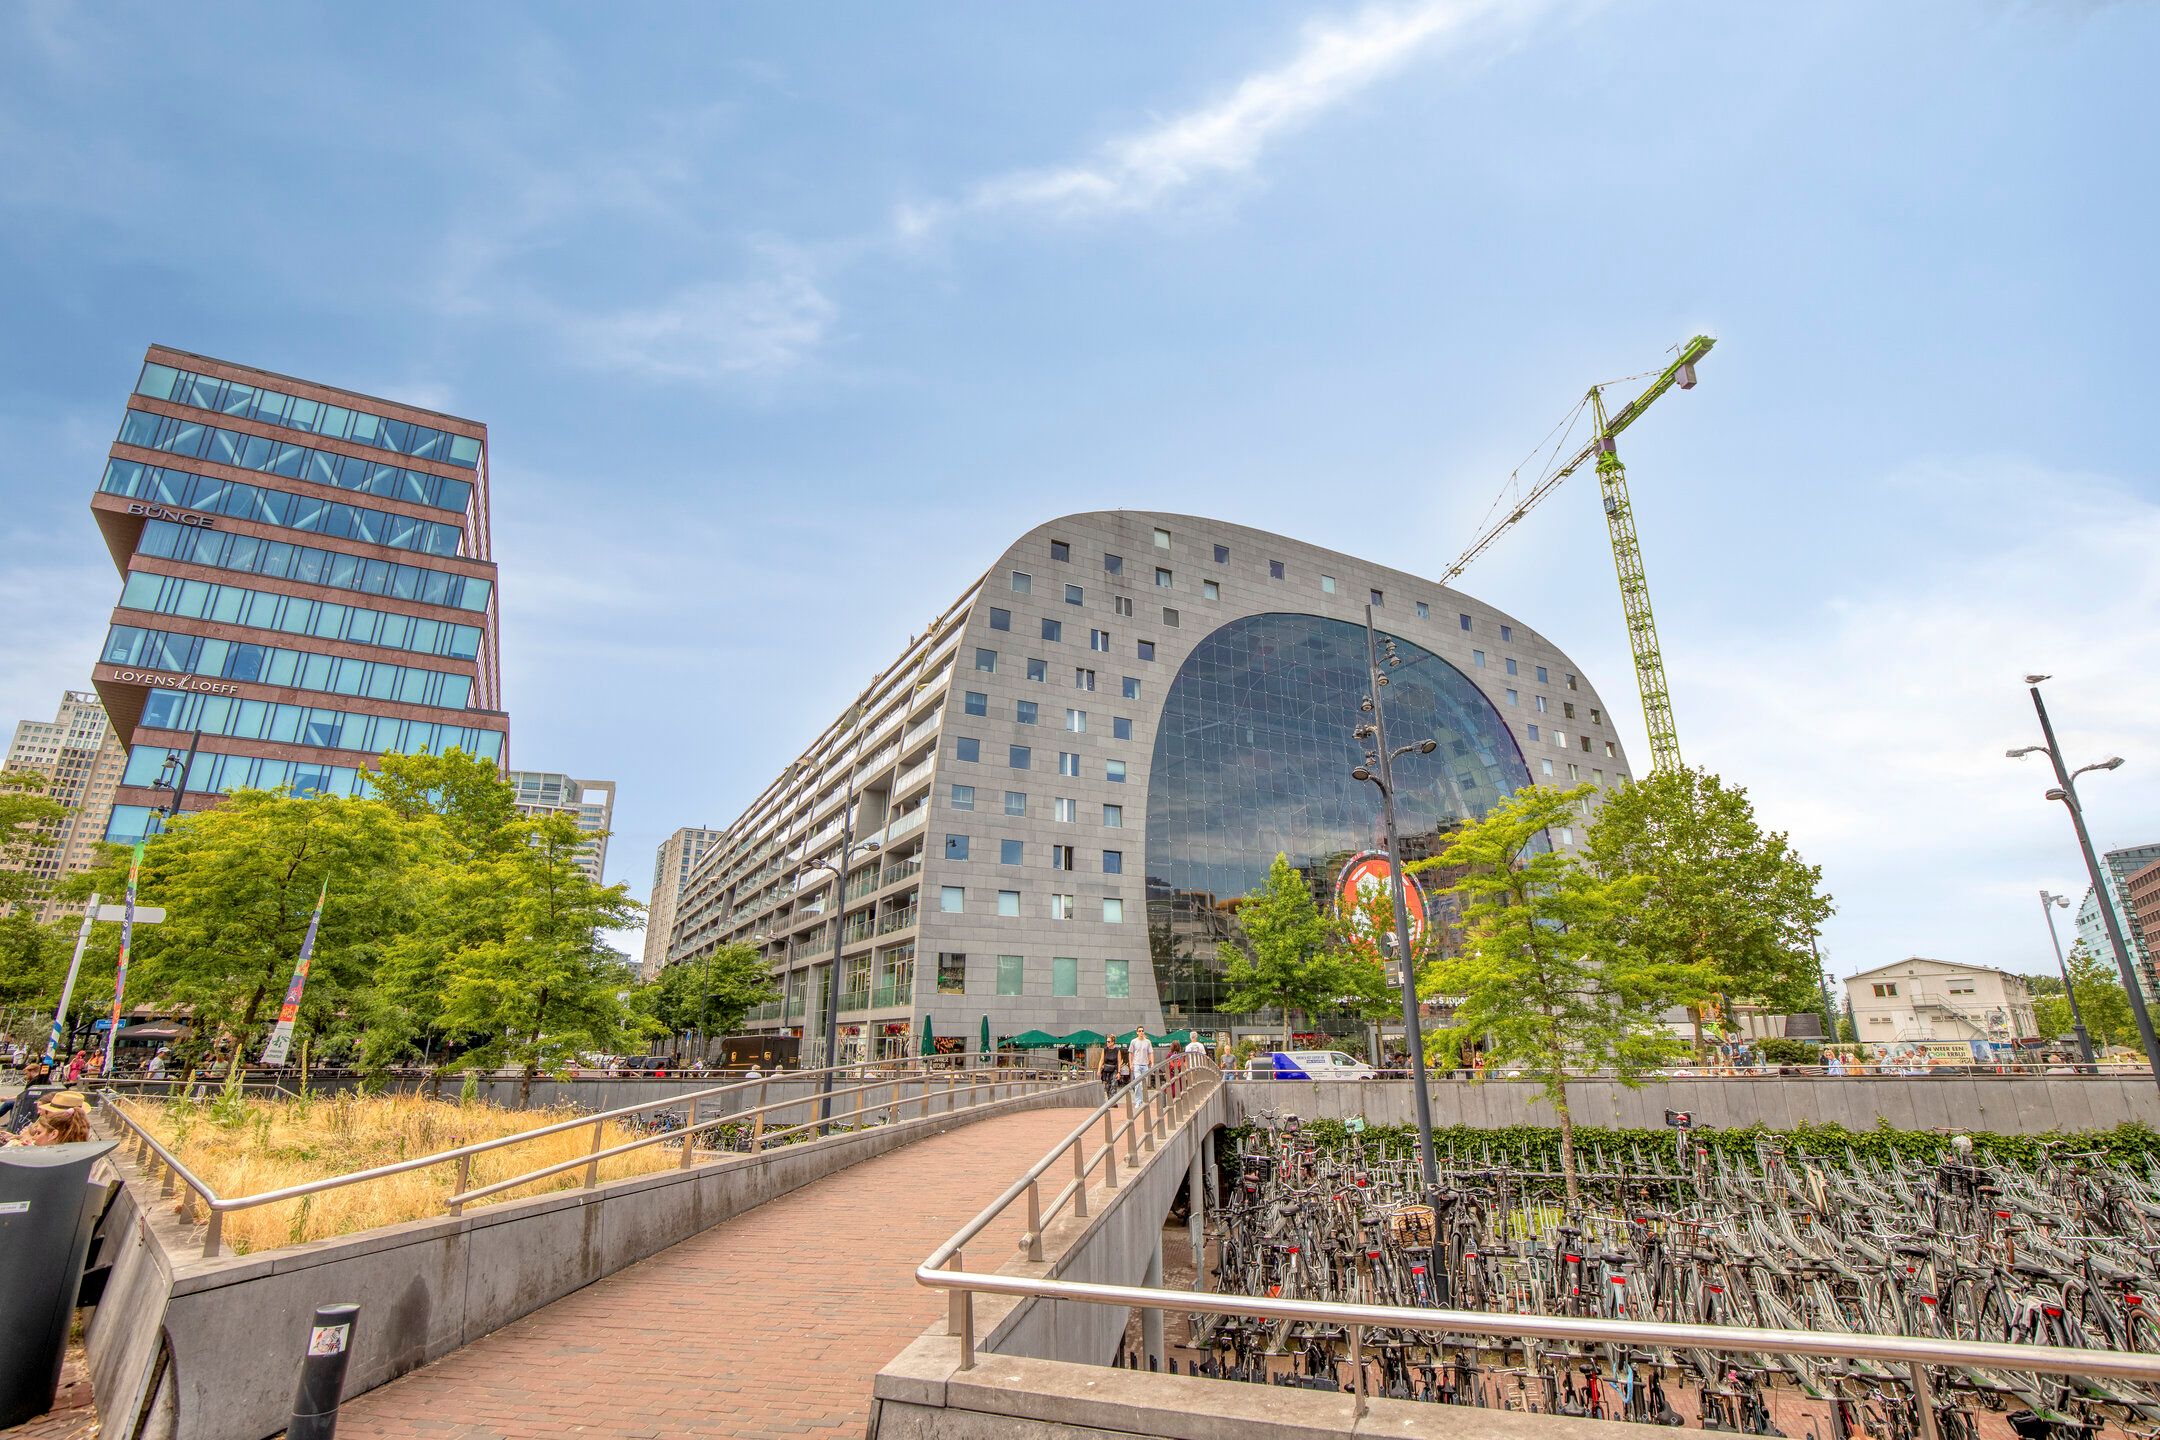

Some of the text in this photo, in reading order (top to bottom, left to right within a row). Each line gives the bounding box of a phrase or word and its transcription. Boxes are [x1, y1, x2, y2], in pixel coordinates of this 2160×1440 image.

[127, 503, 214, 528] BUNGE
[114, 670, 175, 687] LOYENS
[191, 680, 239, 694] LOEFF
